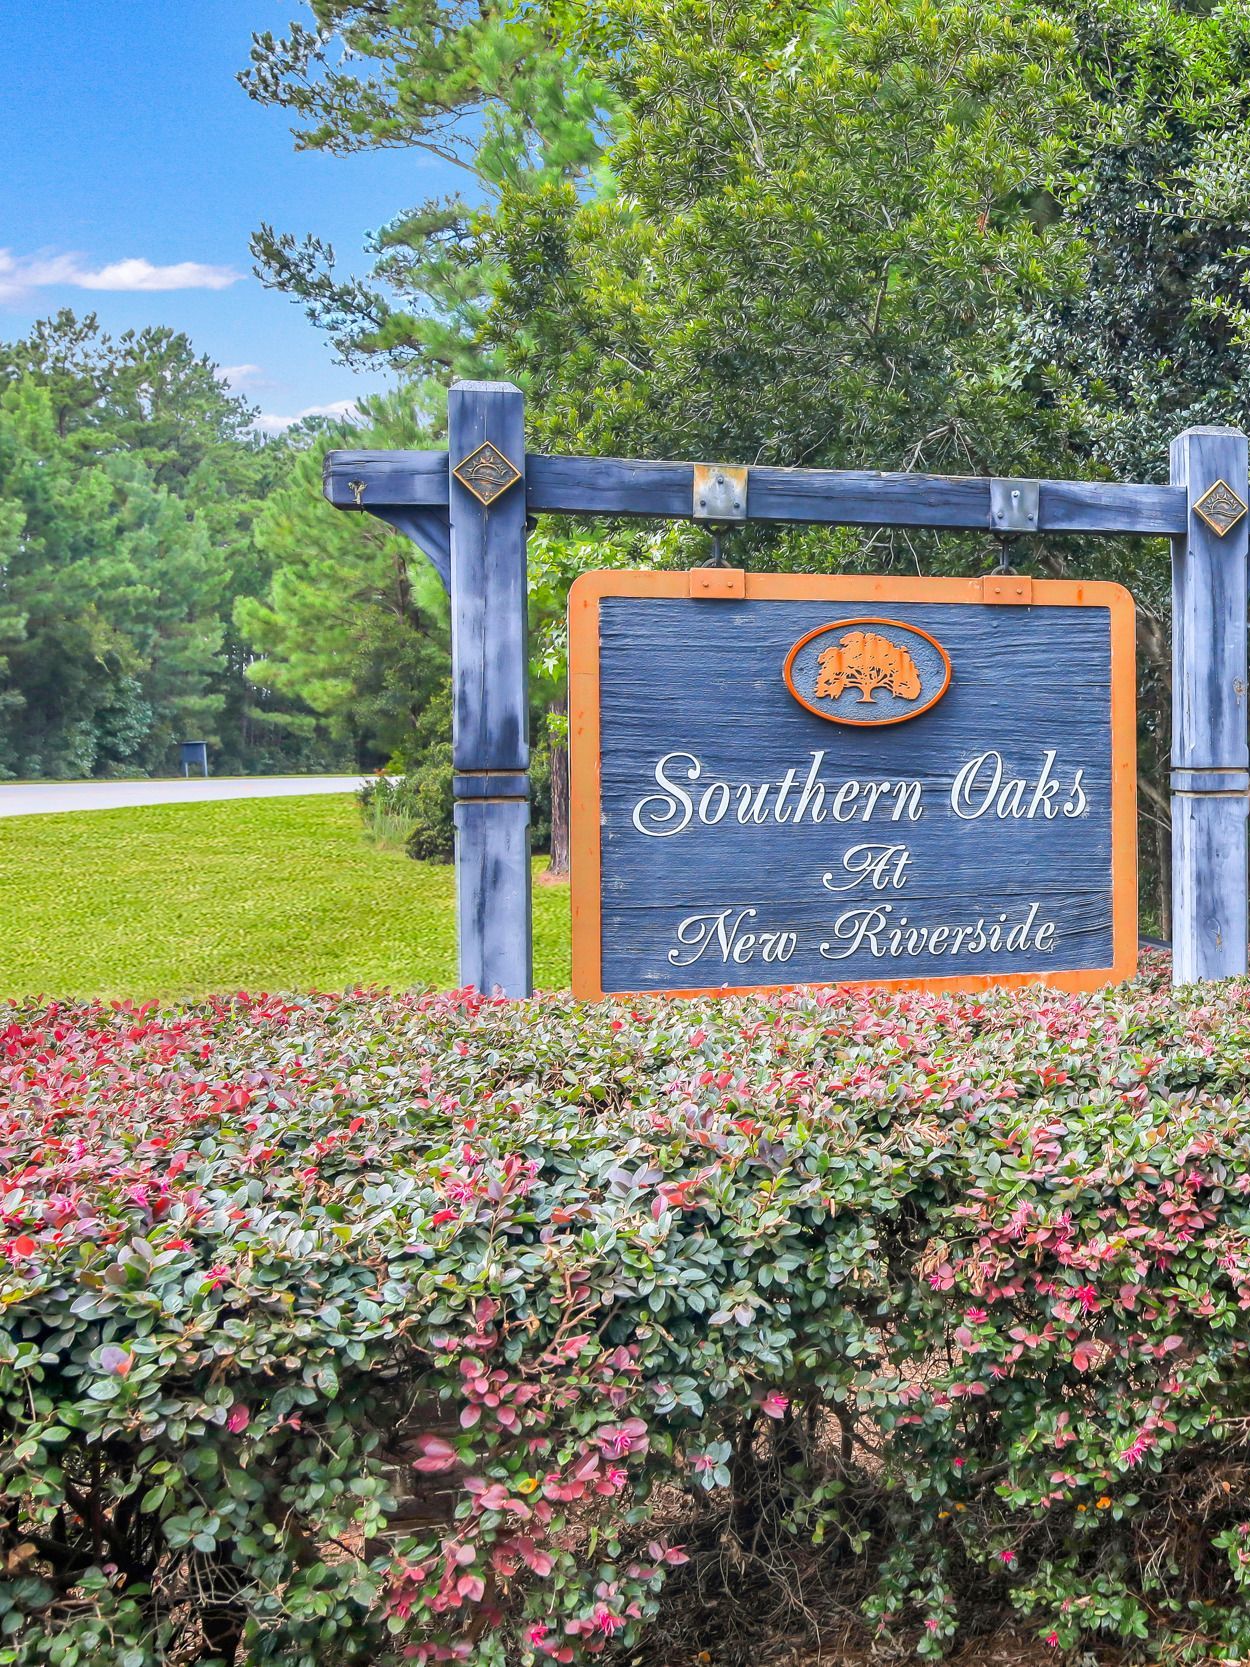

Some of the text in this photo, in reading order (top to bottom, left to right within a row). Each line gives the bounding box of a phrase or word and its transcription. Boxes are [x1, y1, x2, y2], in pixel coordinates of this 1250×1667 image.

[632, 749, 1087, 838] Southern Oaks
[822, 843, 913, 891] At
[667, 902, 1056, 967] New Riverside
